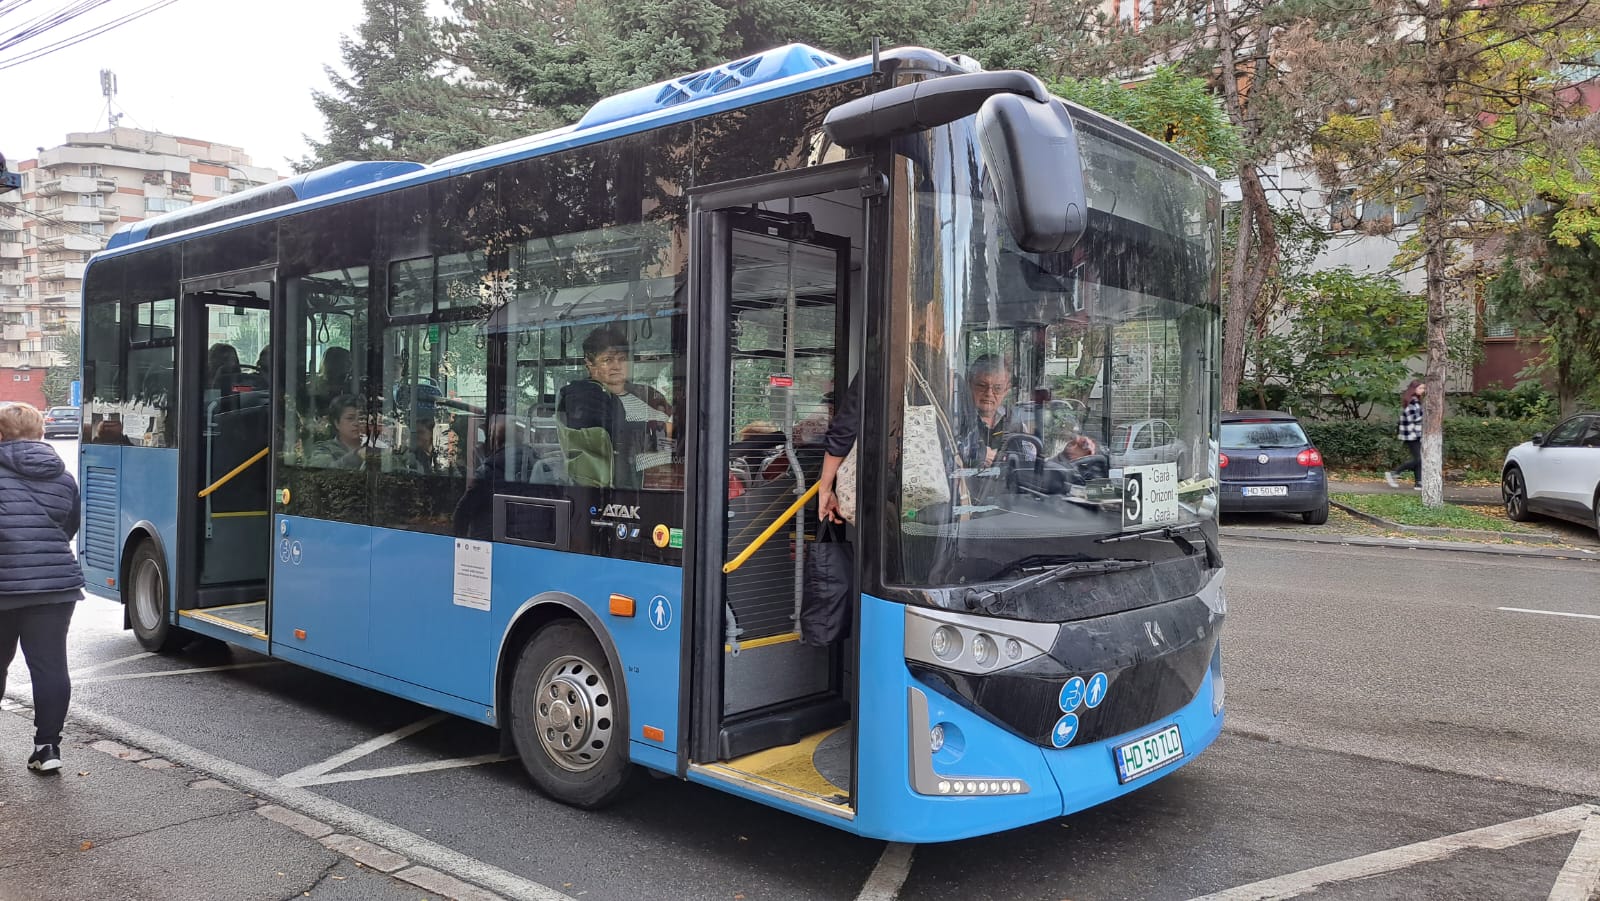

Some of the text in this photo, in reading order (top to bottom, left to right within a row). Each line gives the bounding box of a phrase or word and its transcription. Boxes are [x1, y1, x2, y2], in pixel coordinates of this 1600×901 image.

[1126, 478, 1141, 521] 3
[1150, 488, 1174, 503] Orizont
[1123, 744, 1143, 773] HD
[1143, 738, 1160, 763] 50
[1158, 729, 1180, 757] TLD
